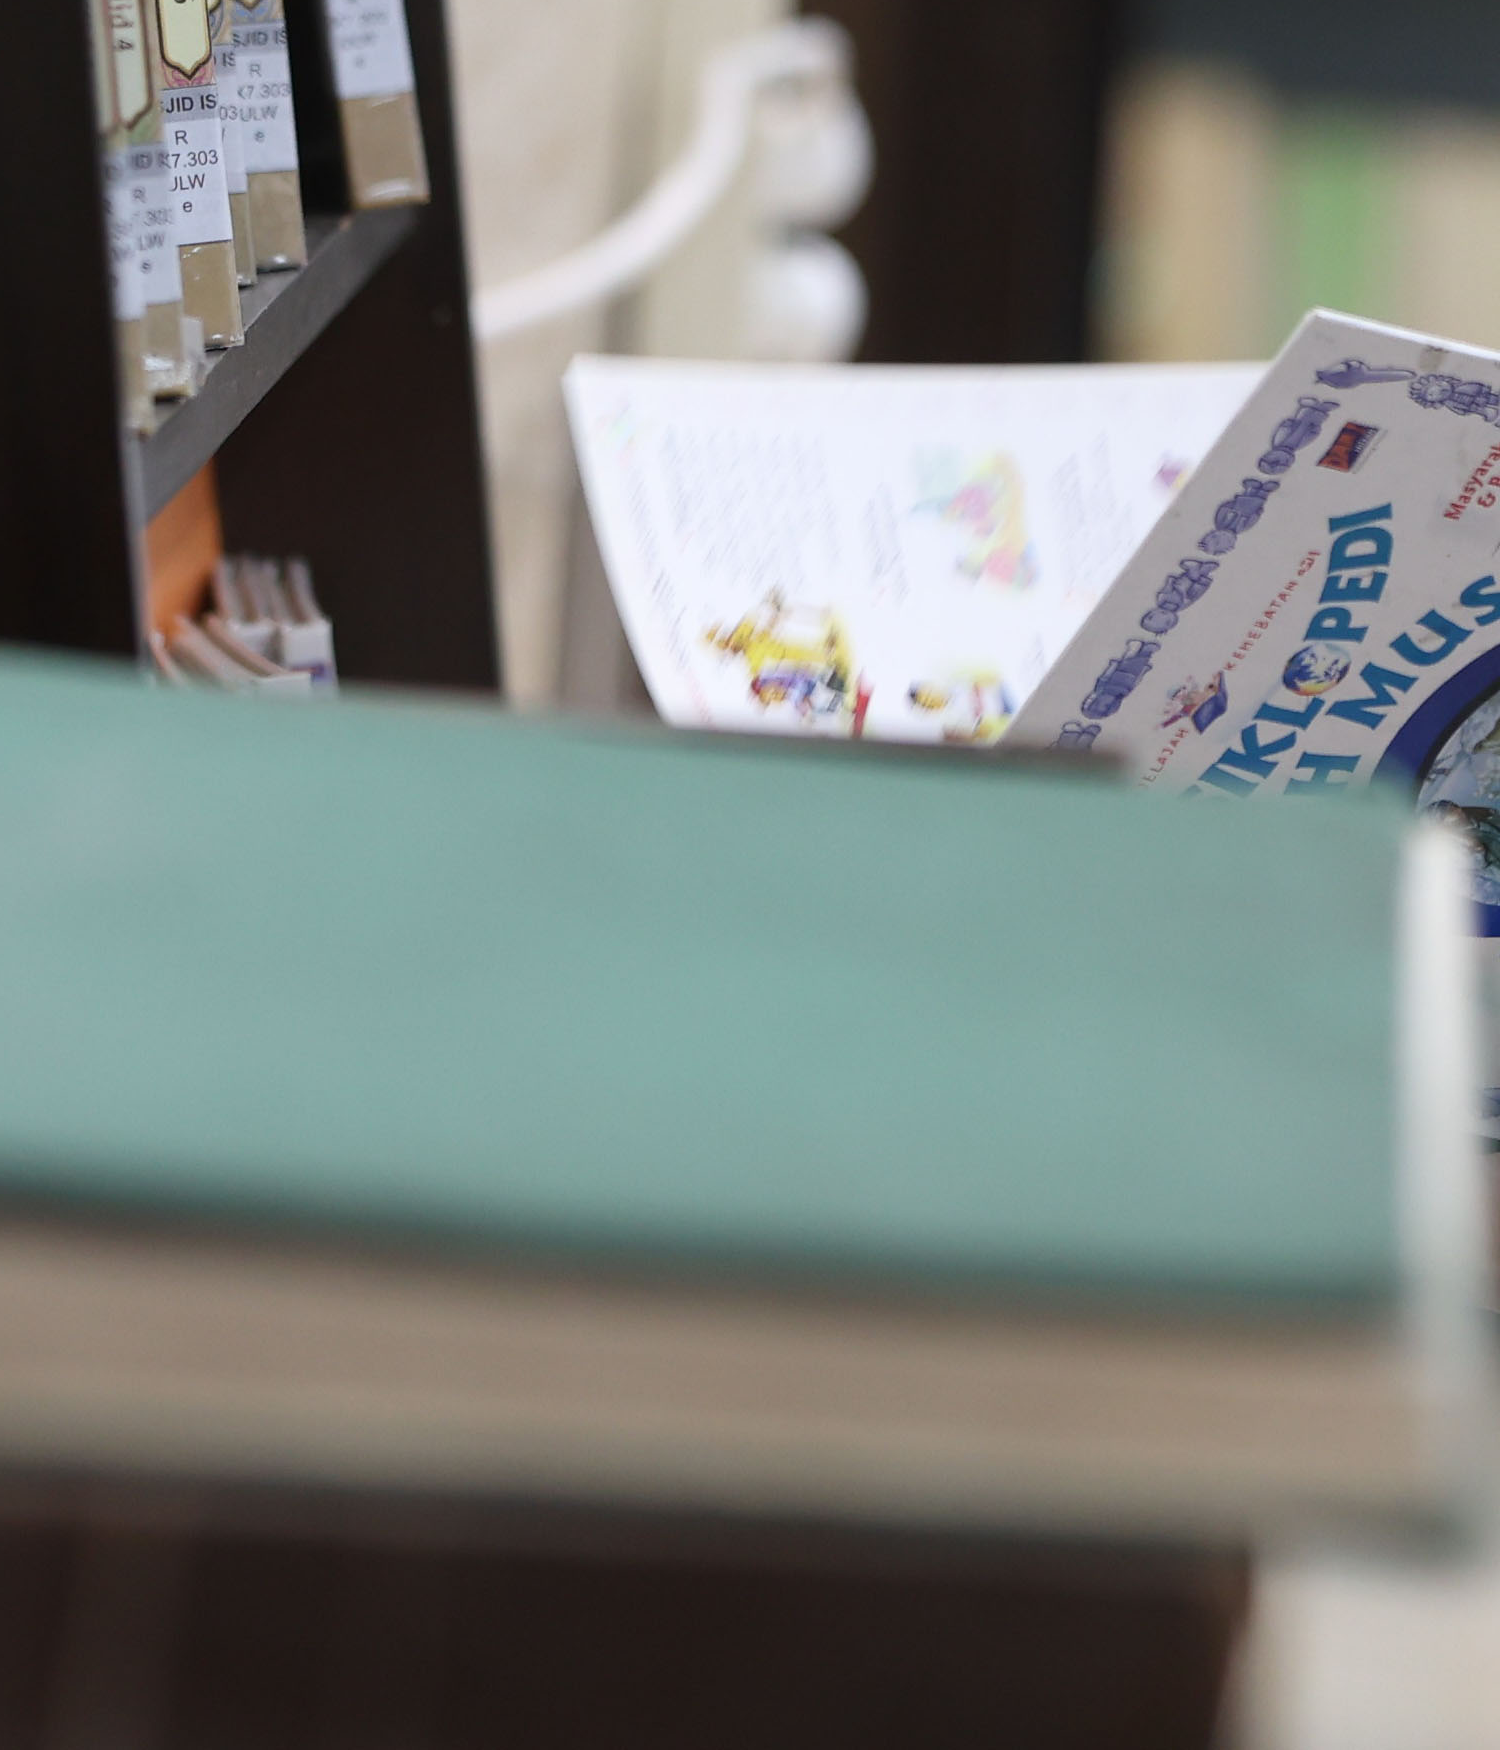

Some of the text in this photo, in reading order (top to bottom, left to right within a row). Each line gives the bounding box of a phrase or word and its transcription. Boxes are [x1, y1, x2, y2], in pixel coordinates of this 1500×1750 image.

[160, 93, 219, 114] JID IS
[174, 130, 189, 146] R
[182, 201, 193, 213] e
[1477, 492, 1497, 509] &
